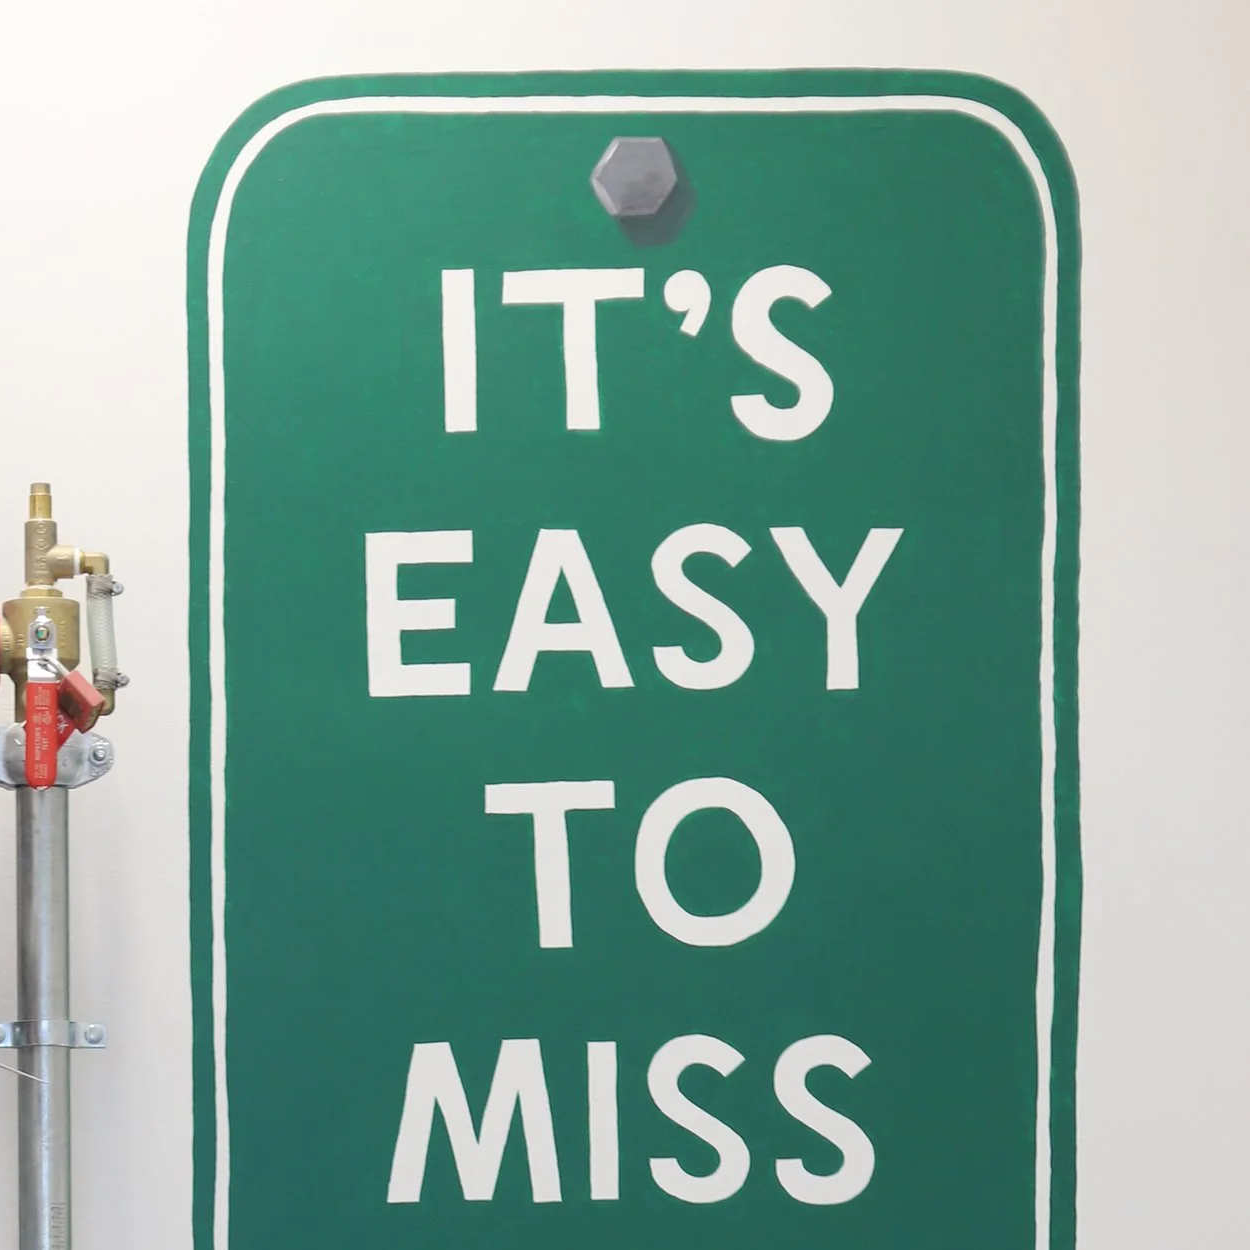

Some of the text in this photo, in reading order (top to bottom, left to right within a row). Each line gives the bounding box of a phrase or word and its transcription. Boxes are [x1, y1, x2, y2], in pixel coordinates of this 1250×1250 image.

[440, 264, 835, 442] IT'S
[364, 522, 905, 698] EASY
[484, 776, 796, 949] TO
[386, 1033, 876, 1206] MISS
